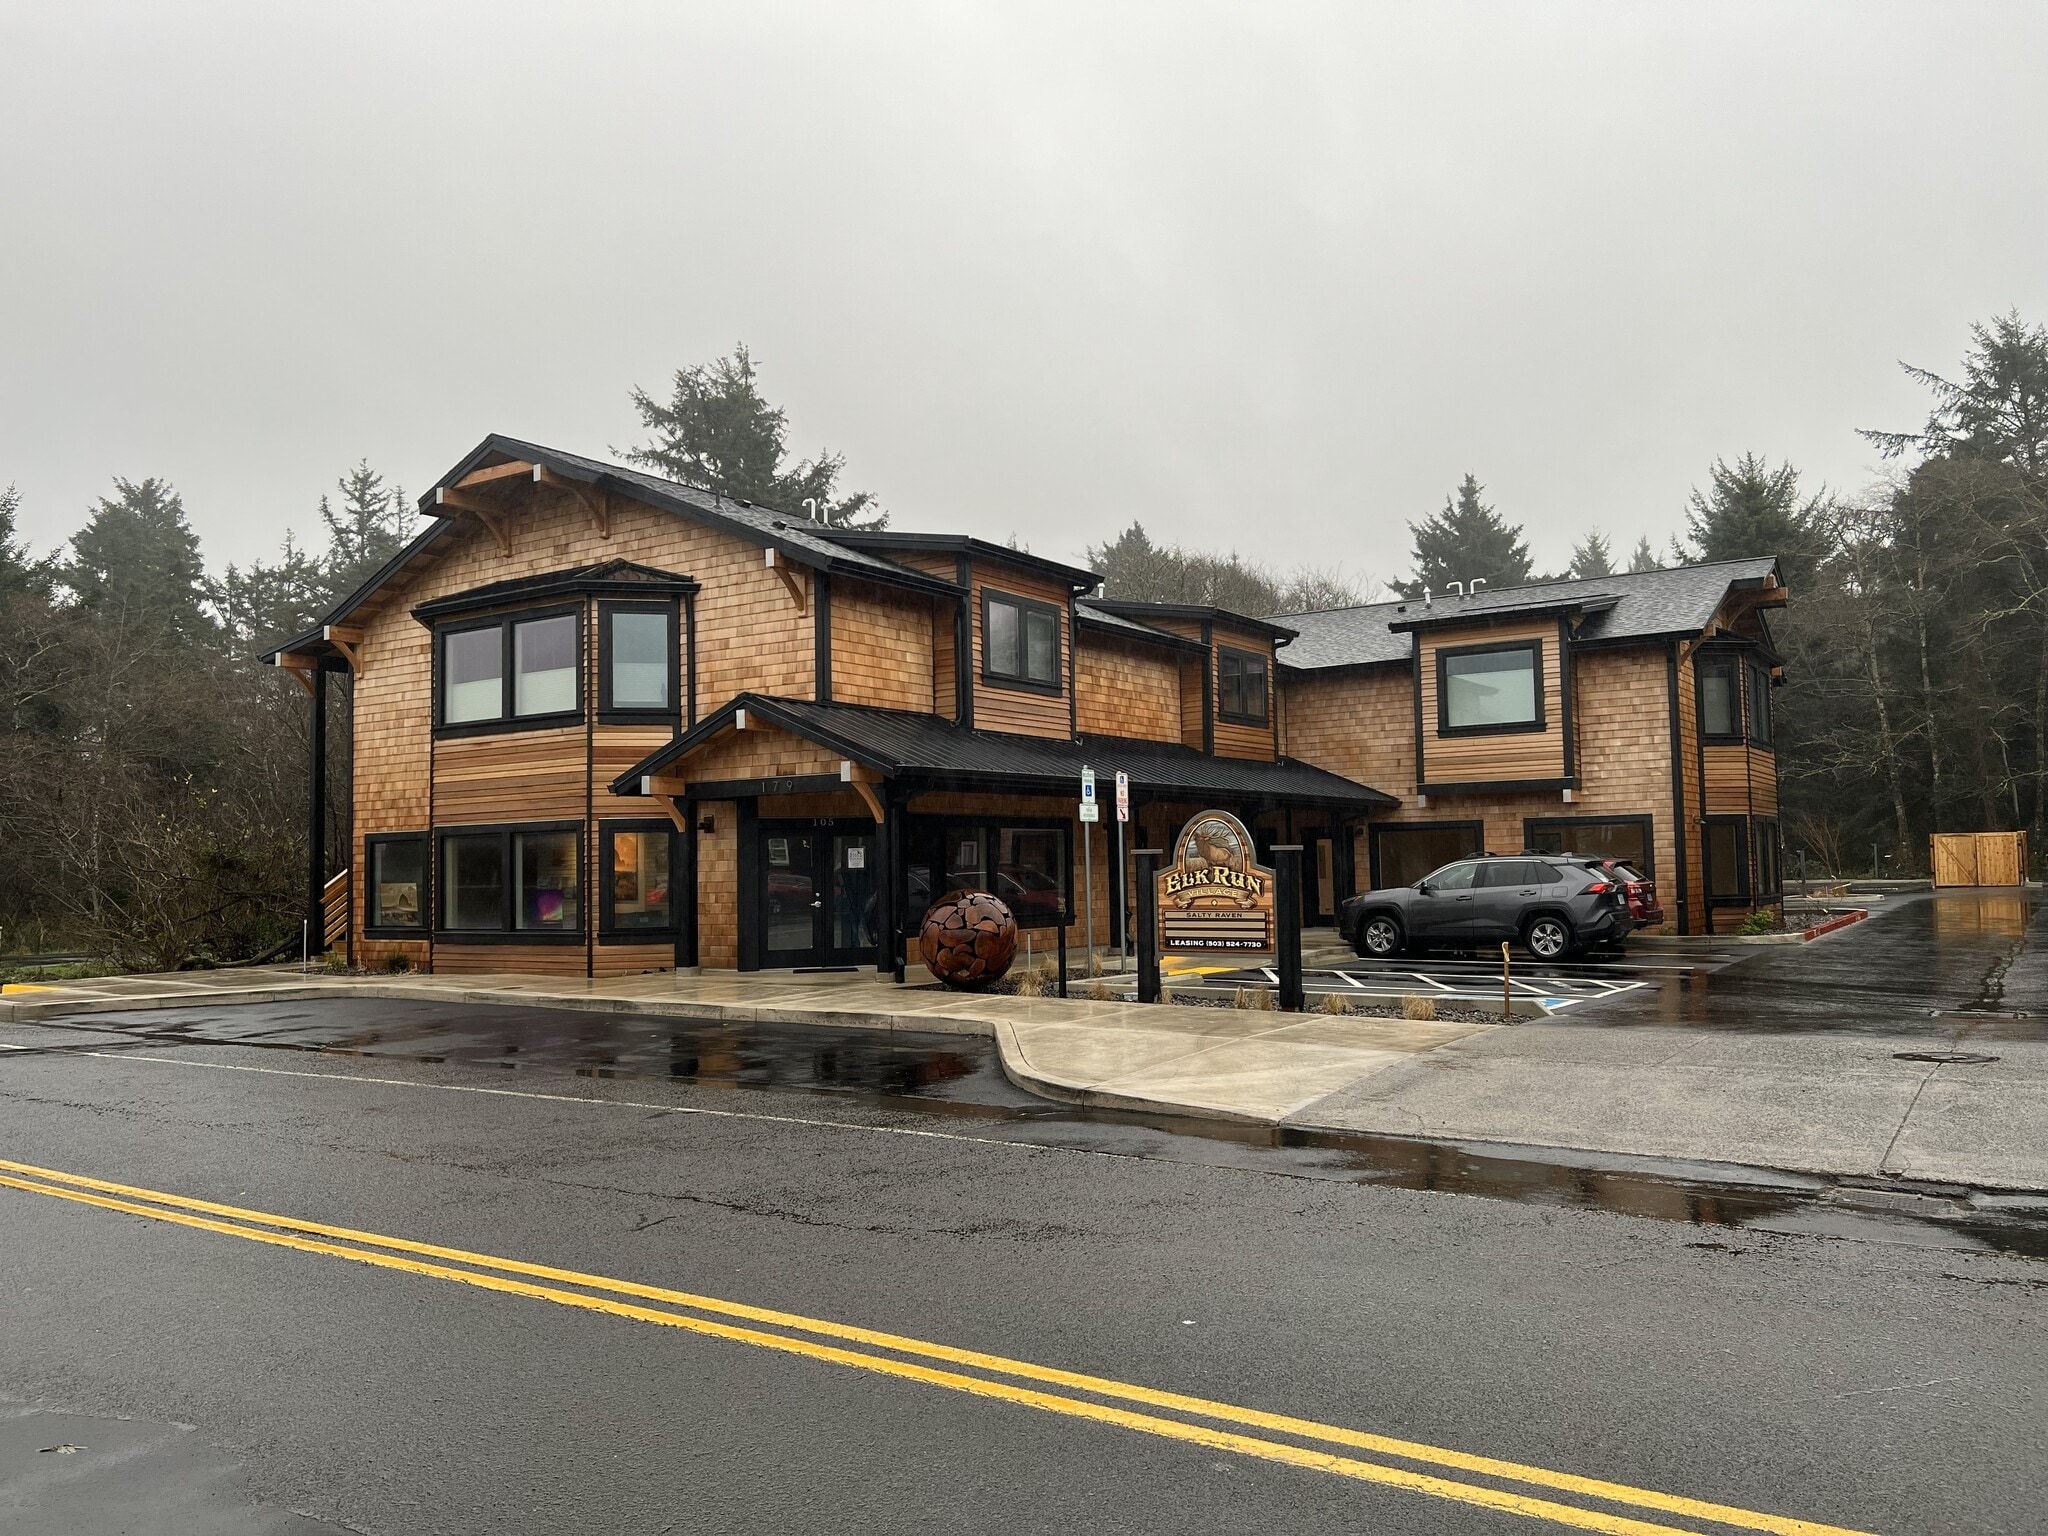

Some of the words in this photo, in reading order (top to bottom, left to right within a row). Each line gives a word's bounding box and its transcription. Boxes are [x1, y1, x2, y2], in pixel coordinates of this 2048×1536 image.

[761, 780, 793, 793] 179
[812, 818, 834, 827] 105
[1165, 869, 1210, 896] ELK
[1212, 866, 1263, 896] RUN
[1187, 888, 1239, 897] VILLAGE
